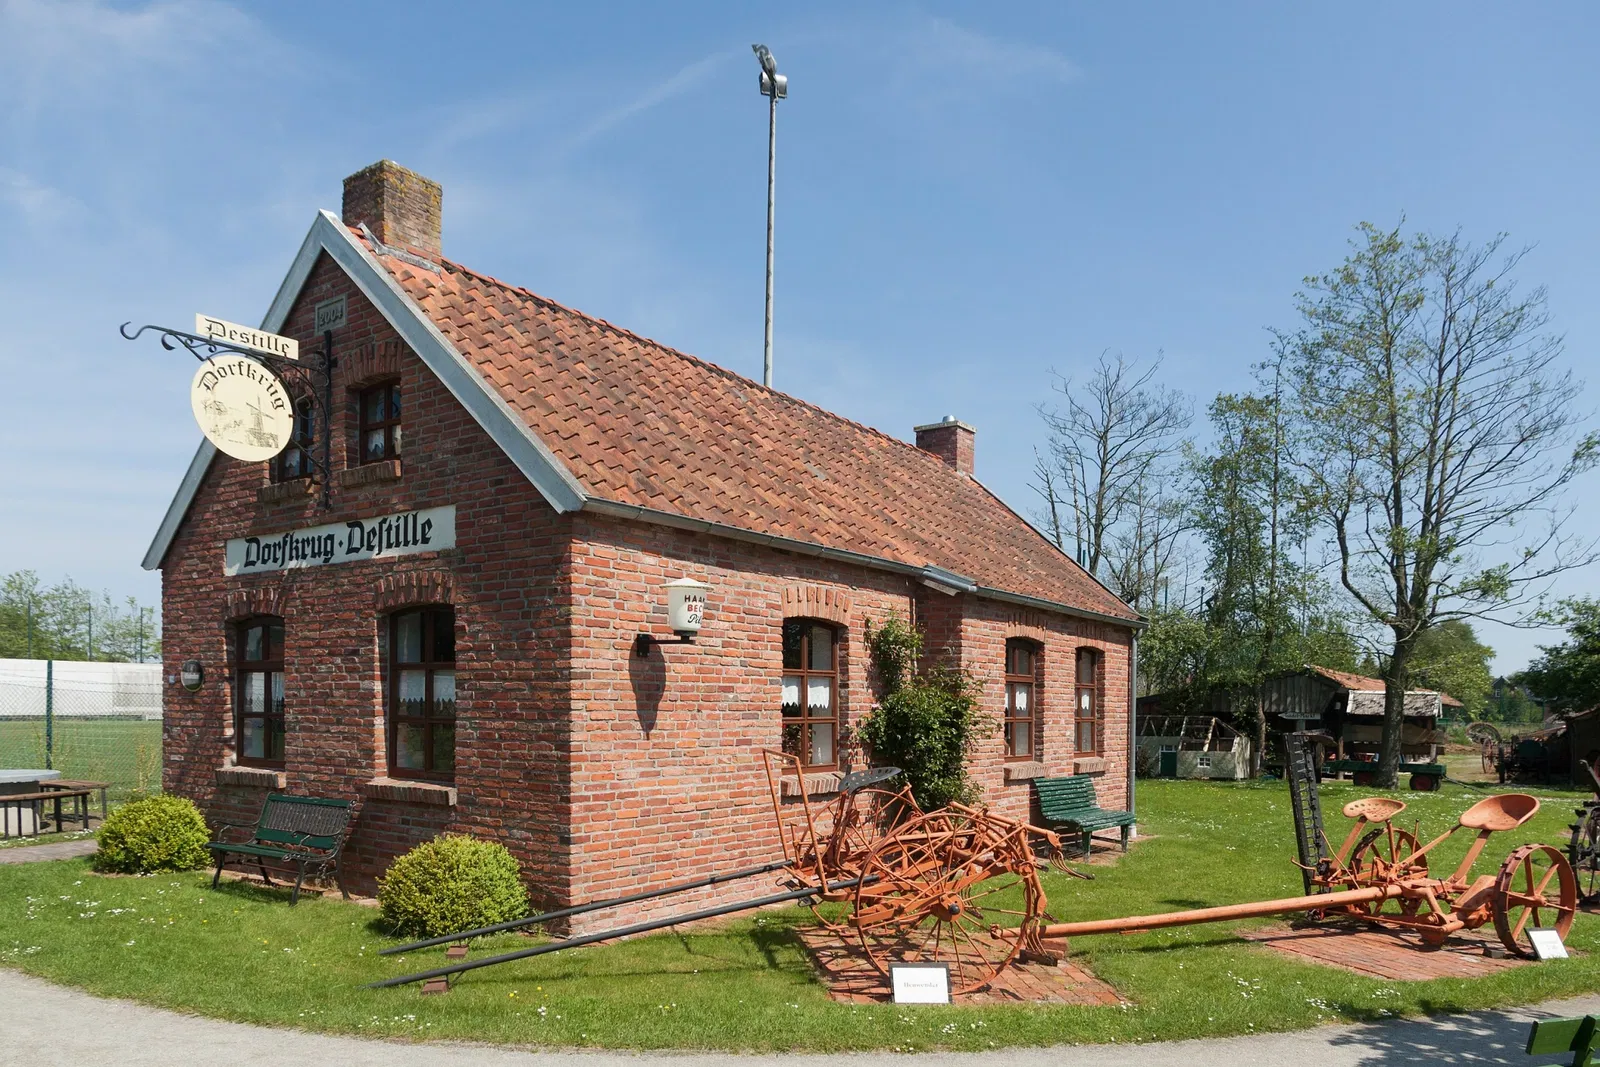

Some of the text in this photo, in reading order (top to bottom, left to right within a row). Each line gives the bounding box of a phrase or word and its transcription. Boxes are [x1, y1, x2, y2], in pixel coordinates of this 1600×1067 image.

[320, 305, 343, 327] 2004
[204, 317, 290, 354] Destille
[197, 360, 285, 411] Dorfkrug
[244, 531, 335, 568] Dorfkrug
